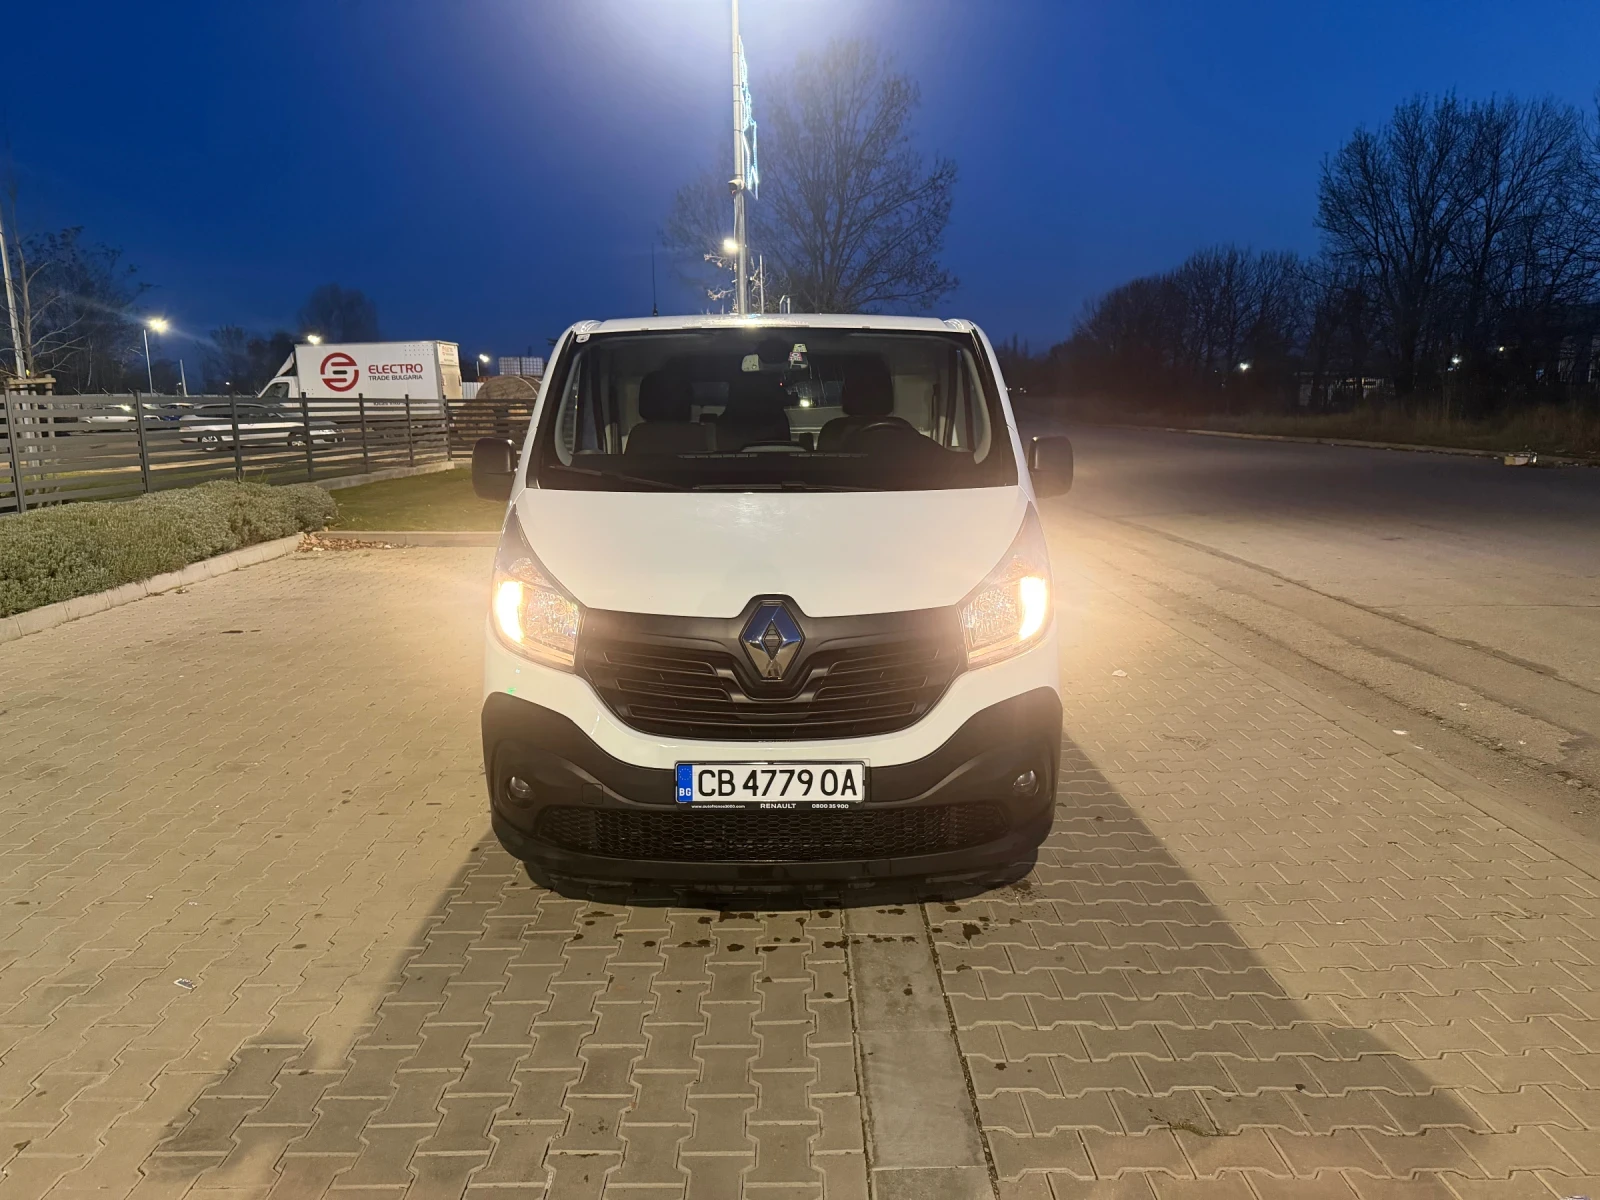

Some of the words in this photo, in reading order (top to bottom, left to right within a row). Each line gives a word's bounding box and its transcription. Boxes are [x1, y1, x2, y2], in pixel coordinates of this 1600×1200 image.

[368, 363, 423, 374] ELECTRO
[698, 769, 736, 797] CB
[742, 769, 813, 797] 4779
[820, 769, 857, 796] OA
[679, 788, 692, 796] BG
